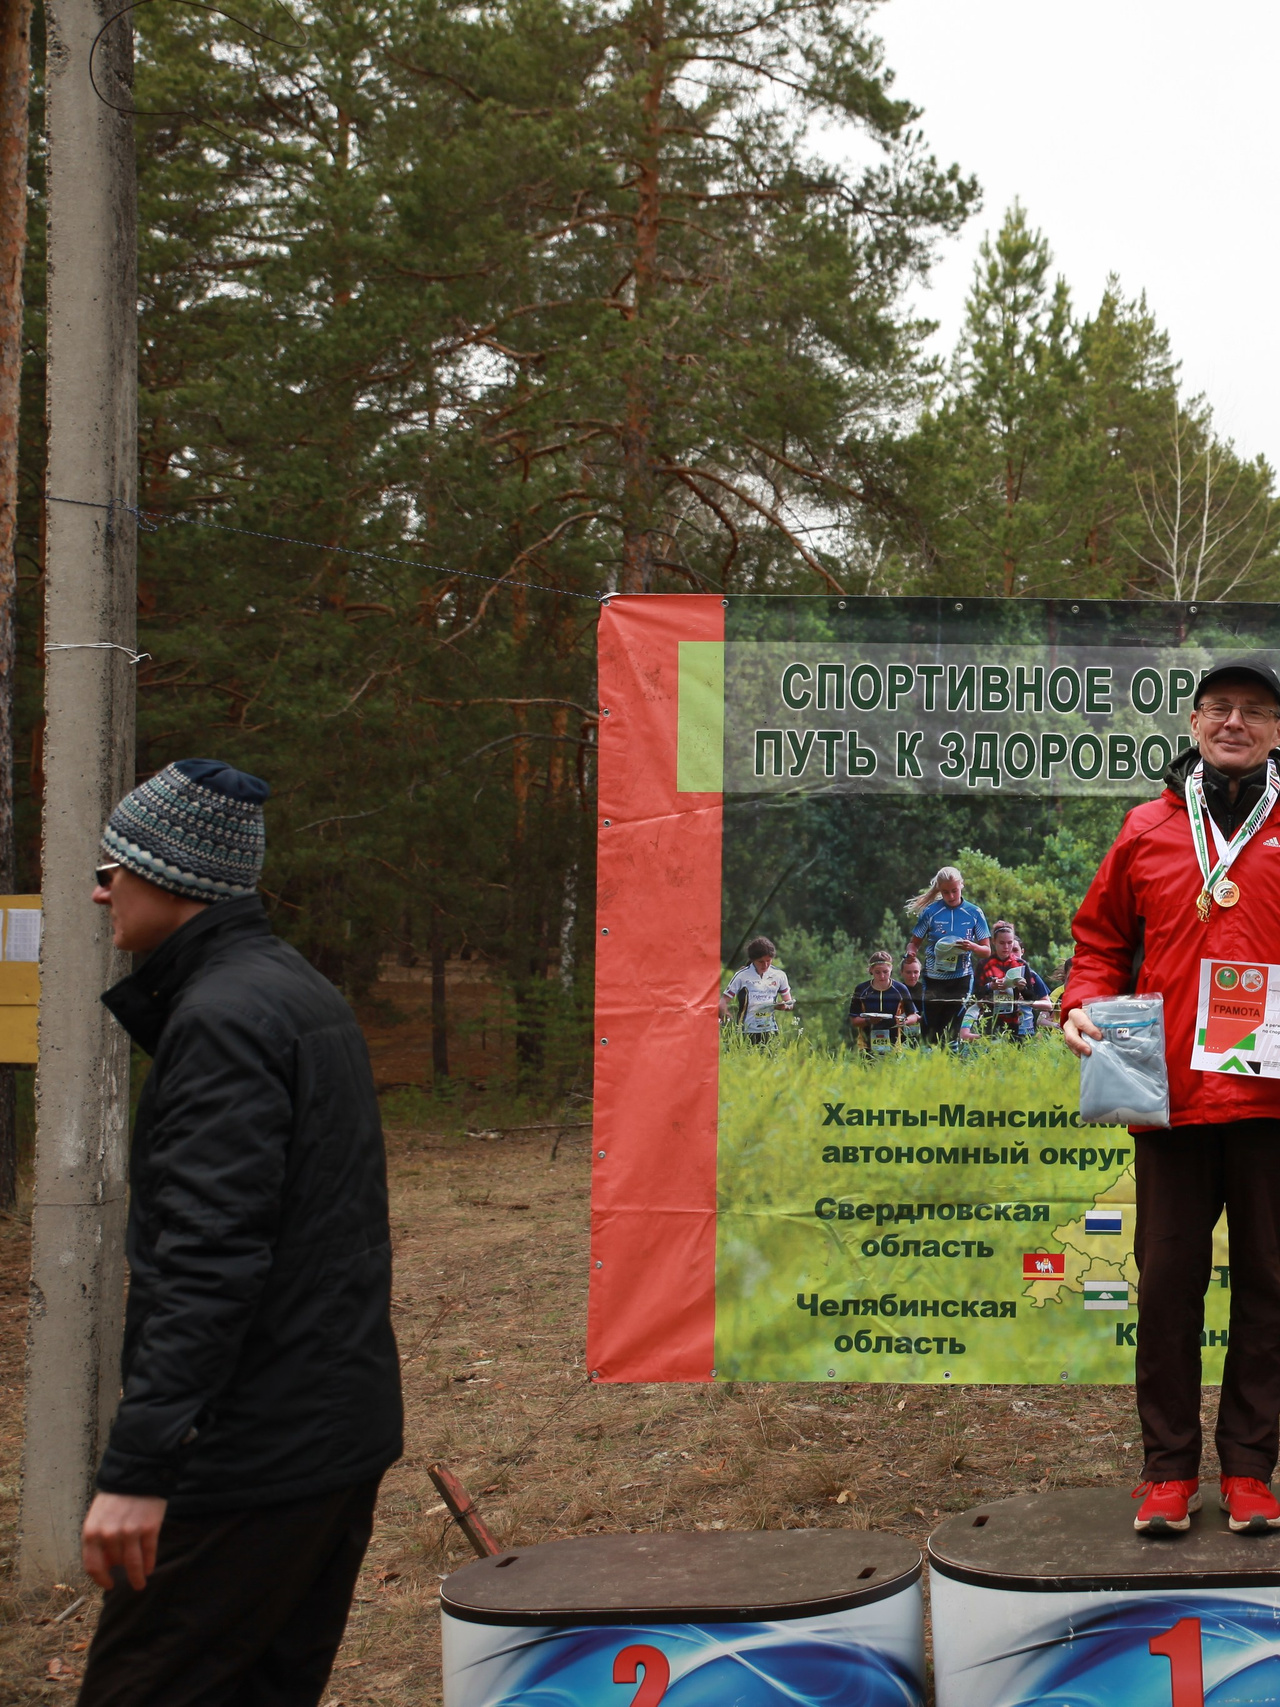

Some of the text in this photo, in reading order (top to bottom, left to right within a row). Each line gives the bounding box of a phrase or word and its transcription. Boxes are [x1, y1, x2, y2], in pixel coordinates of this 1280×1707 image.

[782, 664, 1112, 713] СПОРТИВНОЕ
[754, 730, 877, 777] ПУТЬ
[897, 731, 923, 778] К
[1214, 1004, 1260, 1017] ГРАМОТА
[822, 1141, 1131, 1171] автономный округ
[815, 1198, 1050, 1225] Свердловская
[861, 1235, 994, 1258] область
[796, 1293, 1017, 1318] Челябинская
[834, 1330, 966, 1355] область
[612, 1643, 671, 1707] 2
[1148, 1616, 1205, 1707] 1
